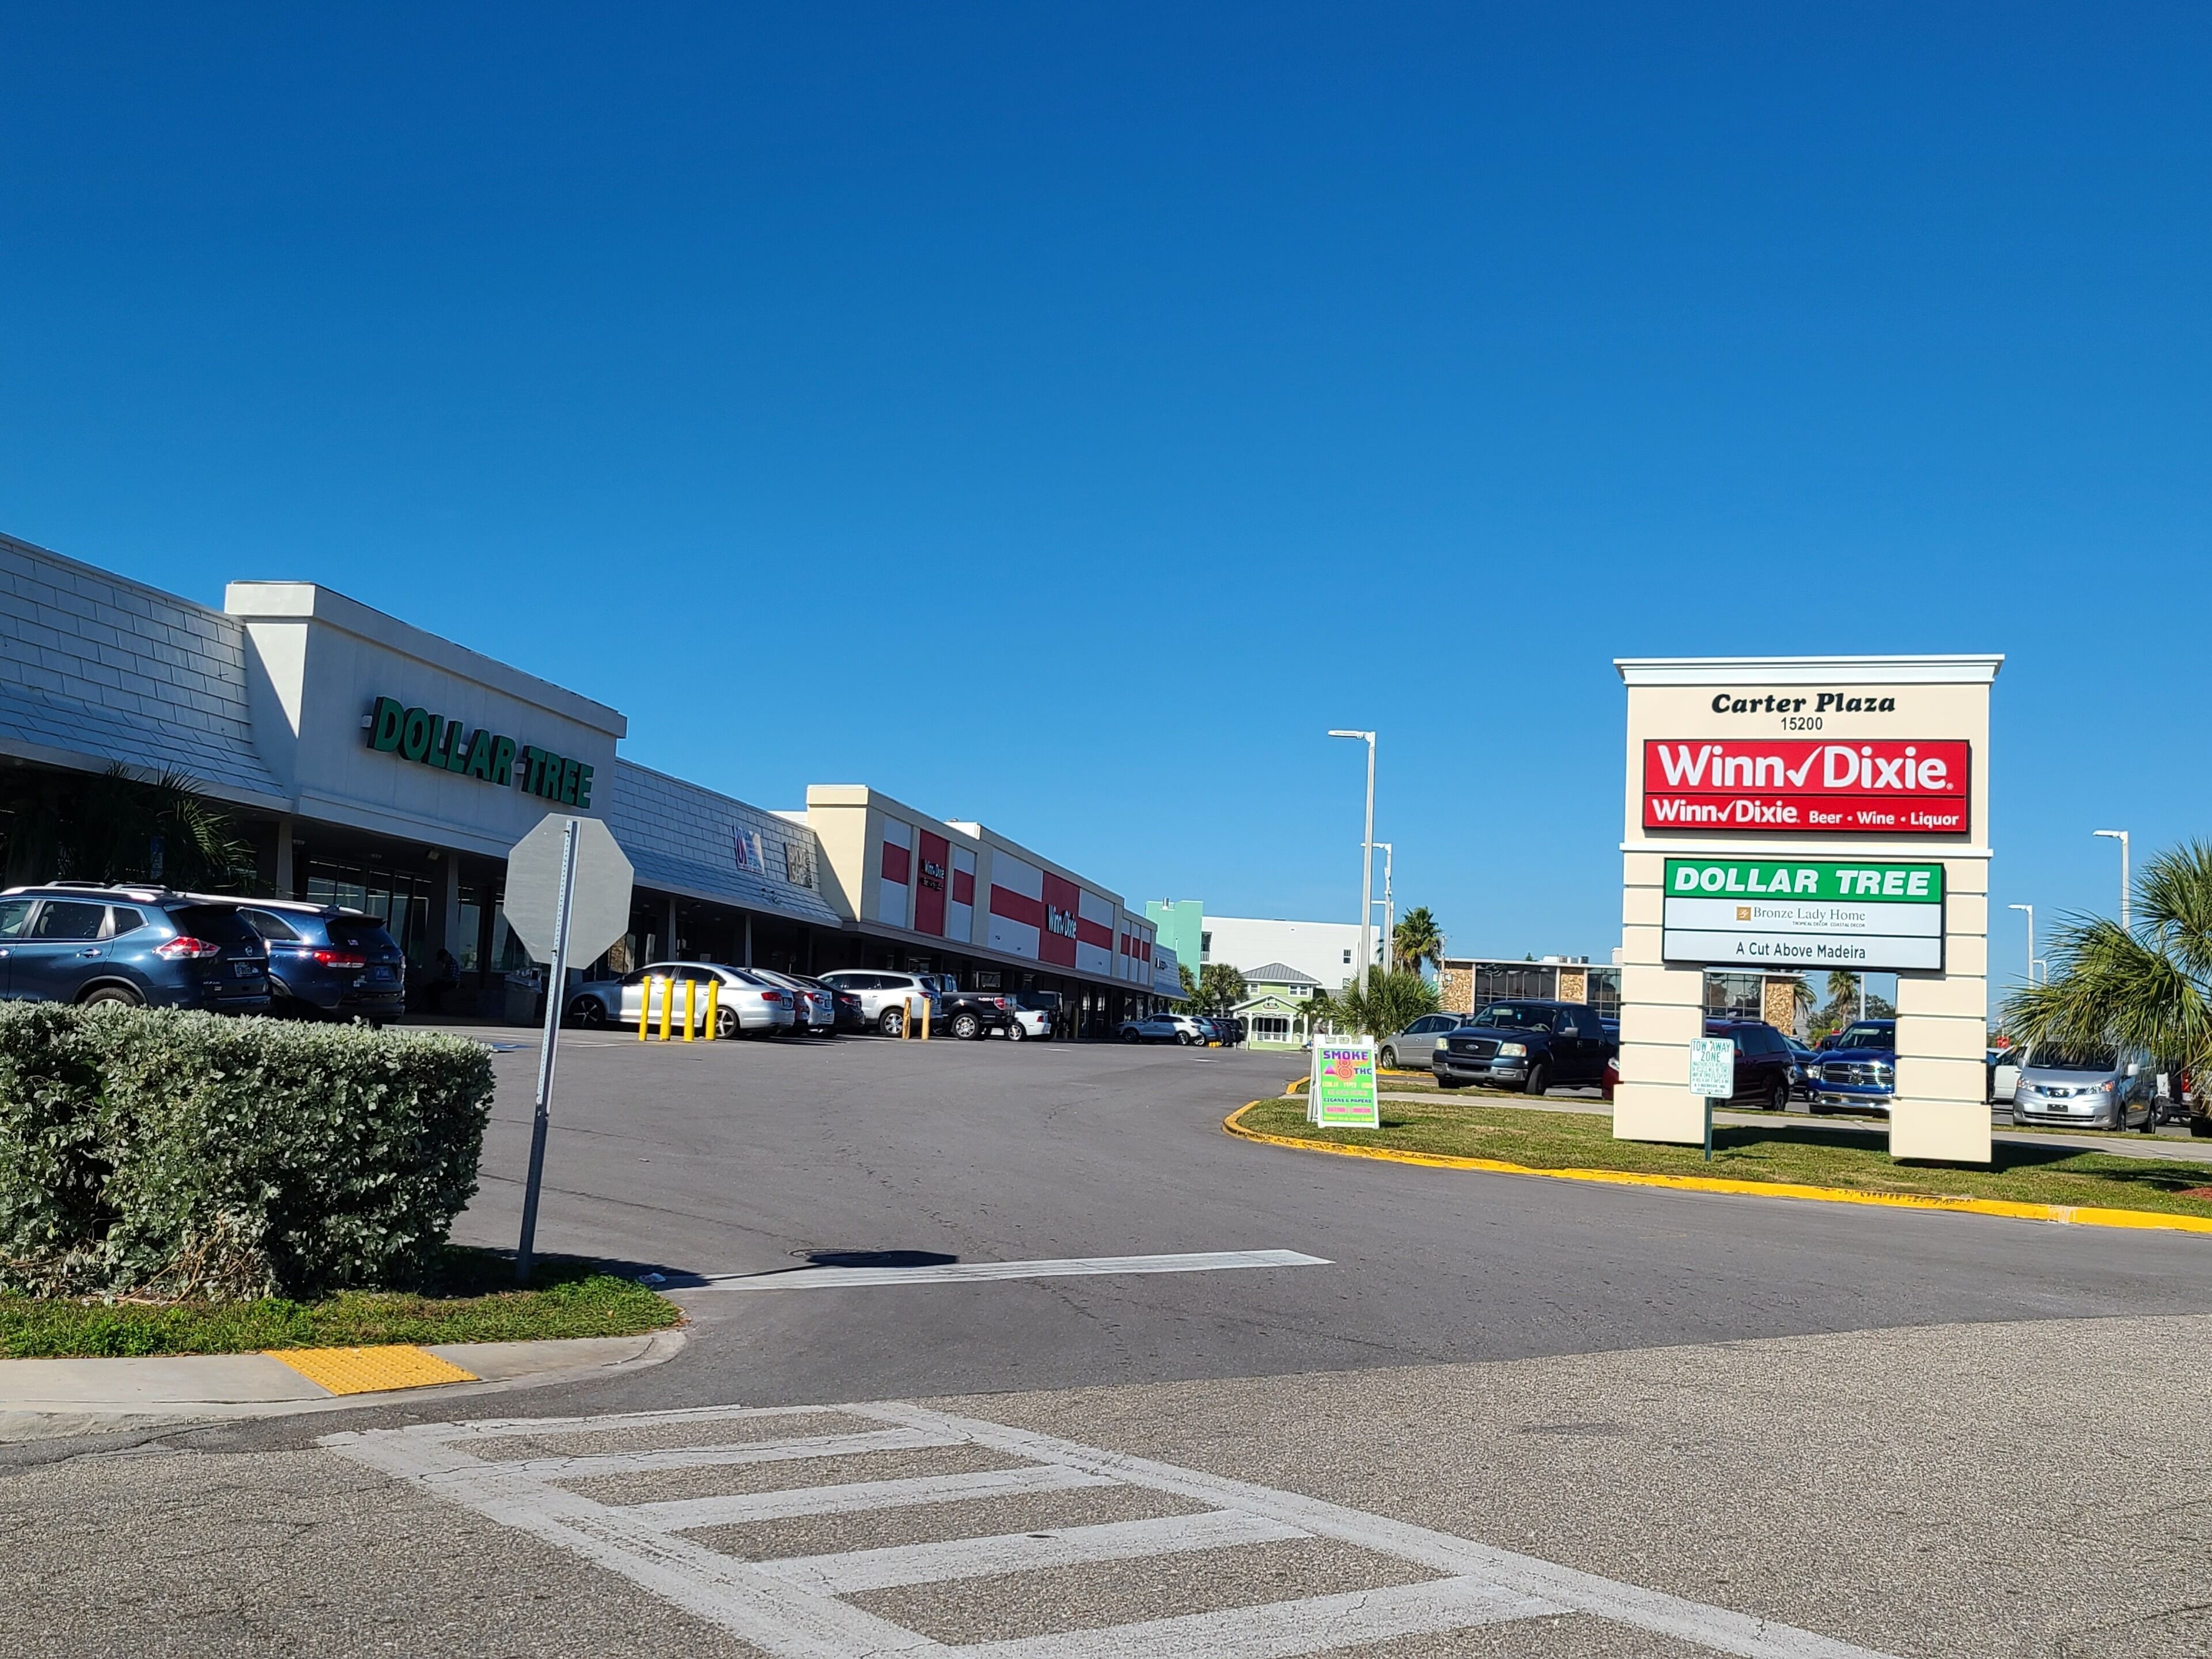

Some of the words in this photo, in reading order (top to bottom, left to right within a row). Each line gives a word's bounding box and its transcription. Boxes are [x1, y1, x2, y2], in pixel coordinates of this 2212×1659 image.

[1711, 694, 1807, 714] Carter
[1816, 693, 1896, 713] Plaza
[1780, 717, 1823, 731] 15200
[367, 696, 517, 786] DOLLAR
[521, 745, 594, 809] TREE
[1809, 810, 1842, 825] Beer
[1857, 811, 1895, 825] Wine
[1910, 812, 1959, 828] Liquor
[1674, 866, 1819, 894] DOLLAR
[1835, 869, 1931, 896] TREE
[1753, 907, 1793, 918] Bronze
[1797, 908, 1826, 923] Lady
[1830, 909, 1866, 921] Home
[1736, 941, 1745, 955] A
[1749, 942, 1770, 956] Cut
[1774, 942, 1813, 957] Above
[1817, 944, 1866, 959] Madeira
[1323, 1050, 1369, 1060] SMOKE
[1692, 1040, 1707, 1051] TOW
[1710, 1041, 1730, 1053] AWAY
[1700, 1051, 1721, 1062] ZONE
